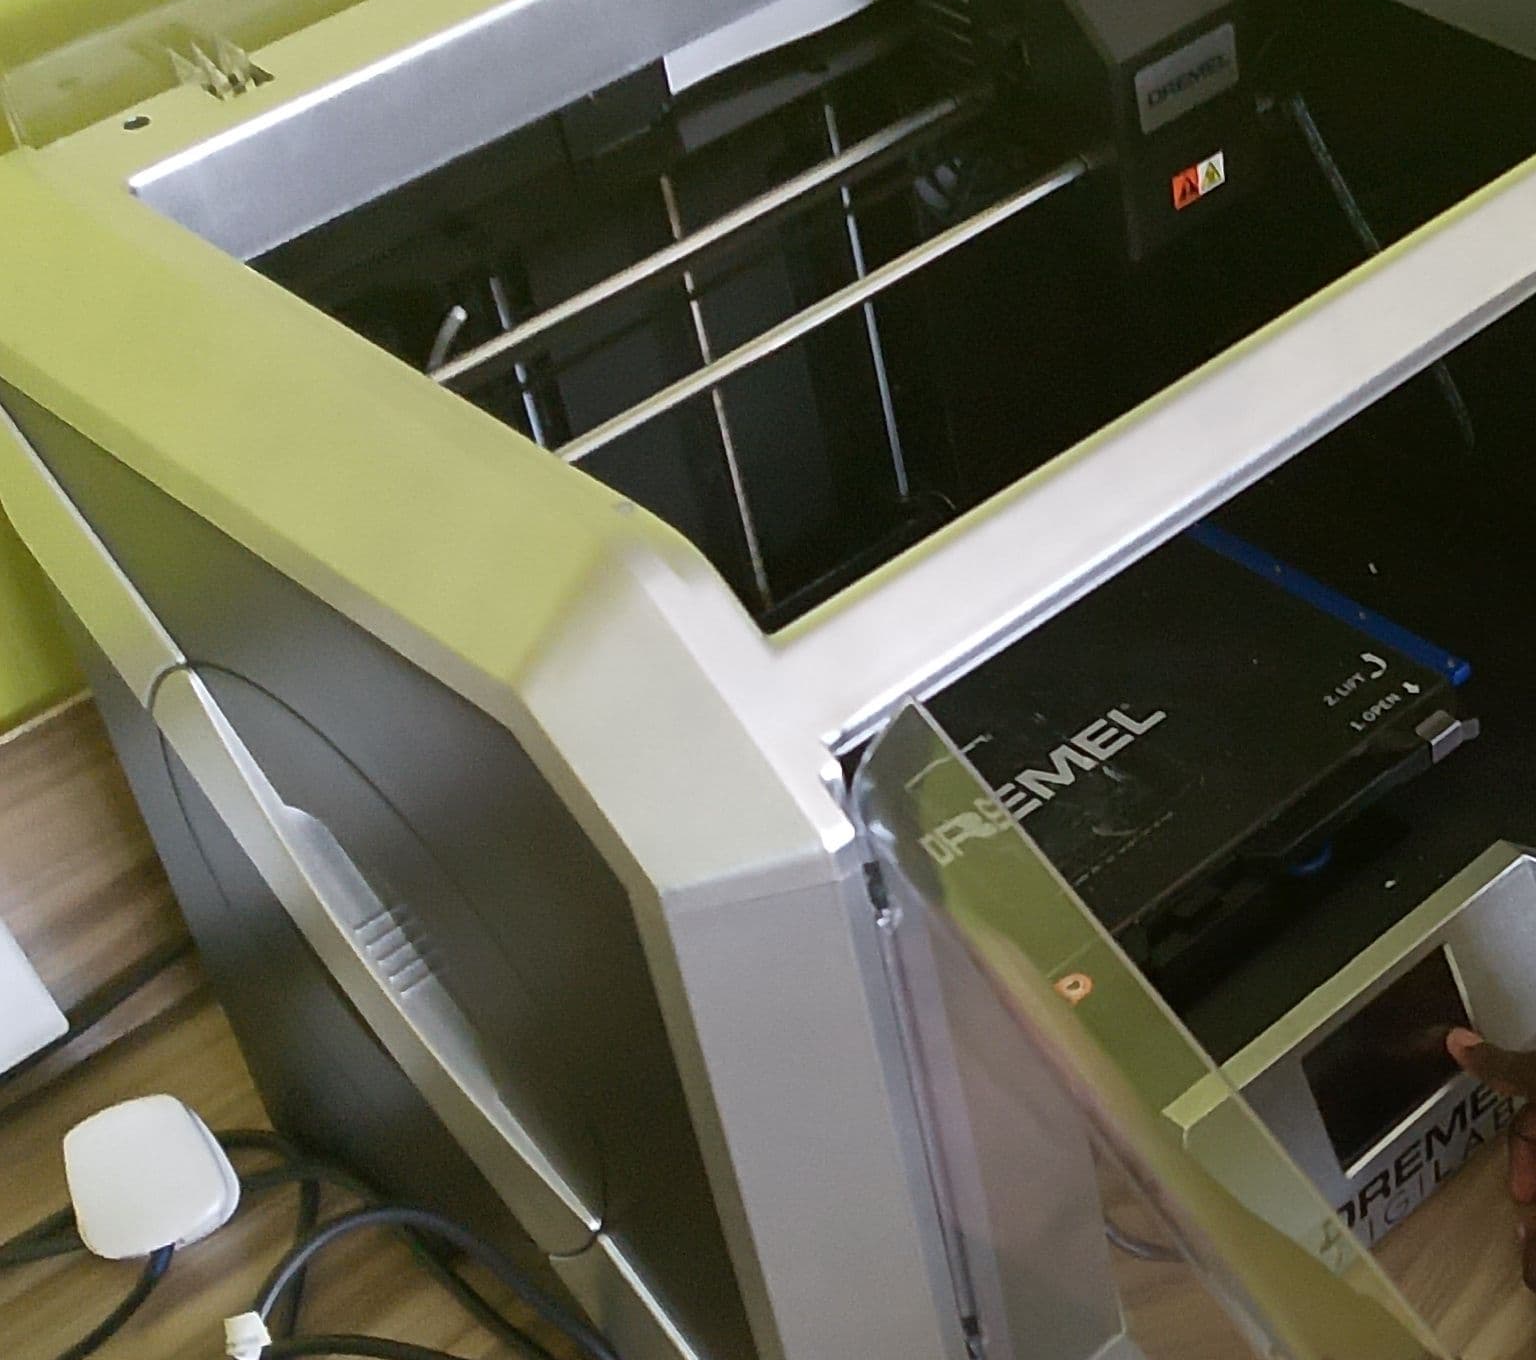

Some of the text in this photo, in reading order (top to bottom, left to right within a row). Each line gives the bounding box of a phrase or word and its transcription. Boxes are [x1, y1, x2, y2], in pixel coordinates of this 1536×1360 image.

[918, 706, 1167, 867] DREMEL
[1362, 692, 1402, 722] OPEN
[1320, 1082, 1499, 1253] DREME
[1334, 1095, 1515, 1261] IGILAB
